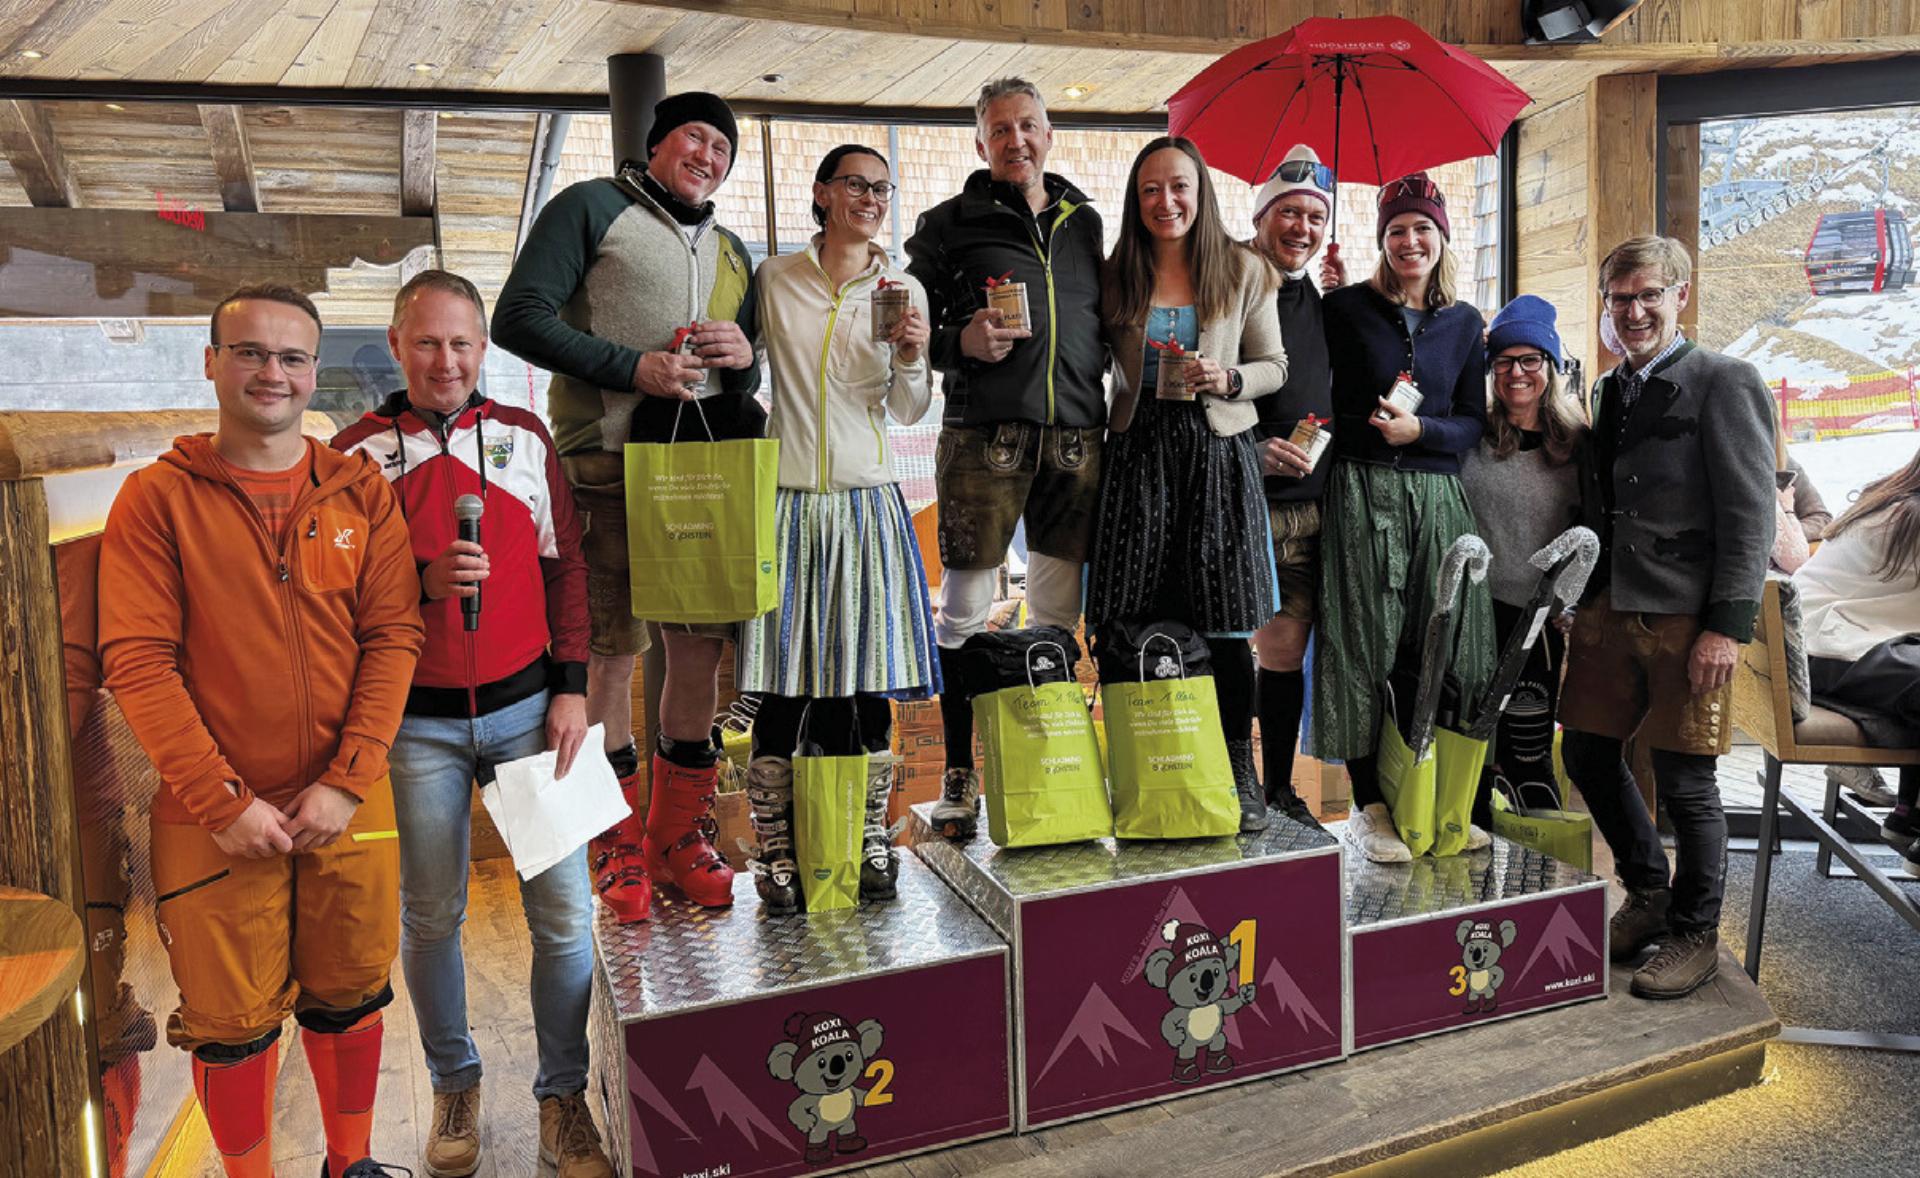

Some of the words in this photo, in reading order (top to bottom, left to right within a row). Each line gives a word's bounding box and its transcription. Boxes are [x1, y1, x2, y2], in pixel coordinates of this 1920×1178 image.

[1470, 931, 1493, 940] KOALA
[1474, 923, 1490, 931] KOXI
[1186, 933, 1210, 946] KOXI
[1185, 945, 1219, 962] KOALA
[1230, 919, 1257, 987] 1
[1449, 965, 1467, 997] 3
[1544, 972, 1596, 992] www.koxi.ski
[813, 1018, 842, 1034] KOXI
[811, 1029, 850, 1049] KOALA
[864, 1059, 895, 1107] 2
